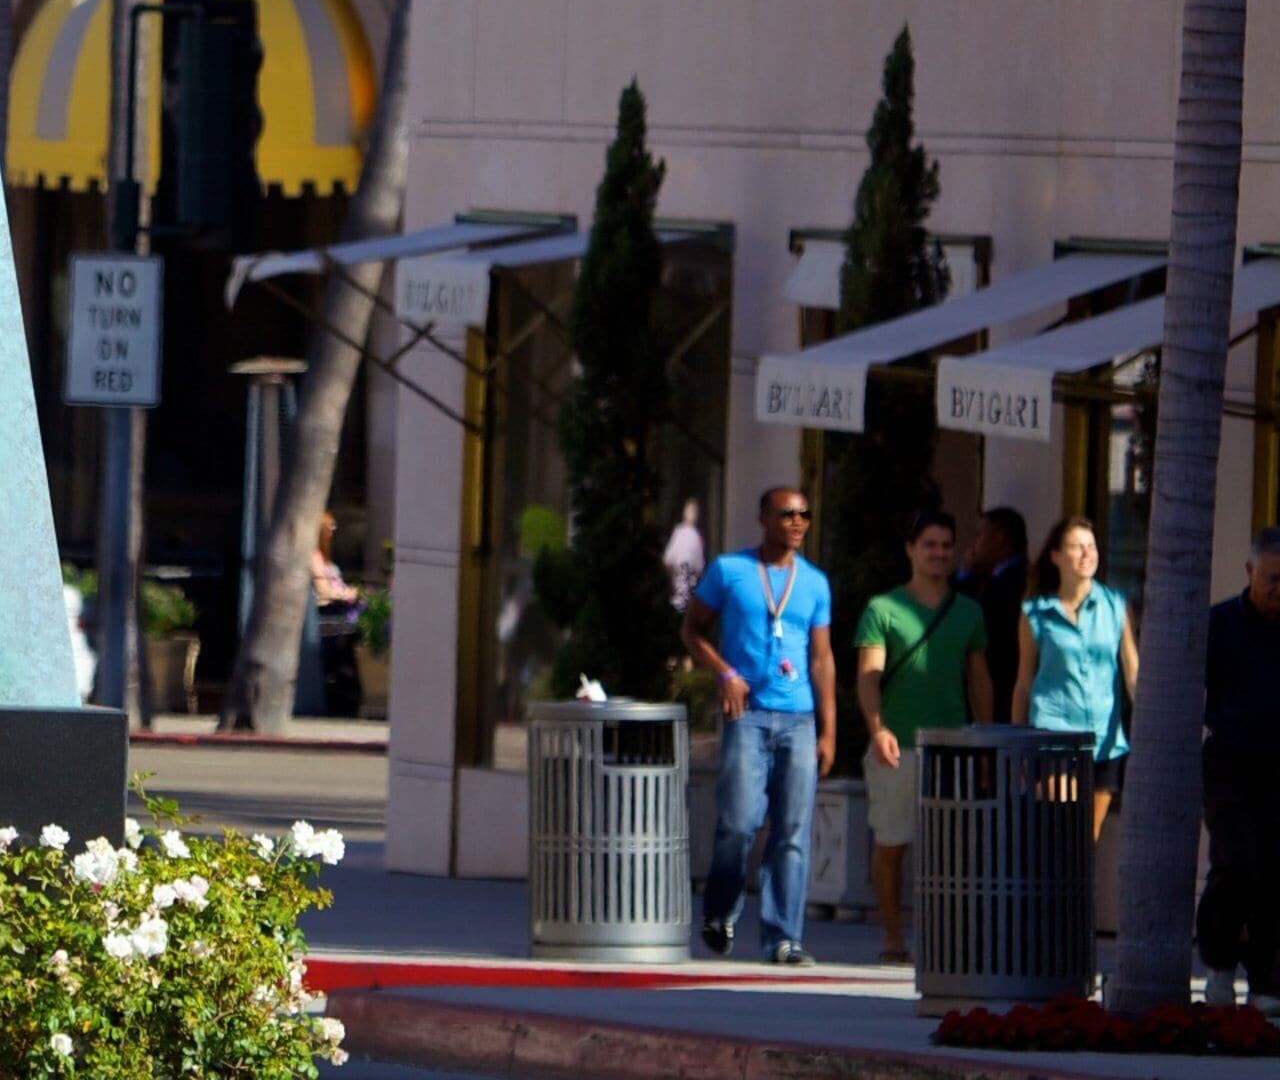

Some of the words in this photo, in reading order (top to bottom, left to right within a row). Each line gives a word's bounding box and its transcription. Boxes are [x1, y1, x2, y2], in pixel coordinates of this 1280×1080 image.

[96, 271, 137, 298] NO
[89, 304, 142, 330] TURN
[97, 338, 128, 361] ON
[94, 370, 133, 393] RED
